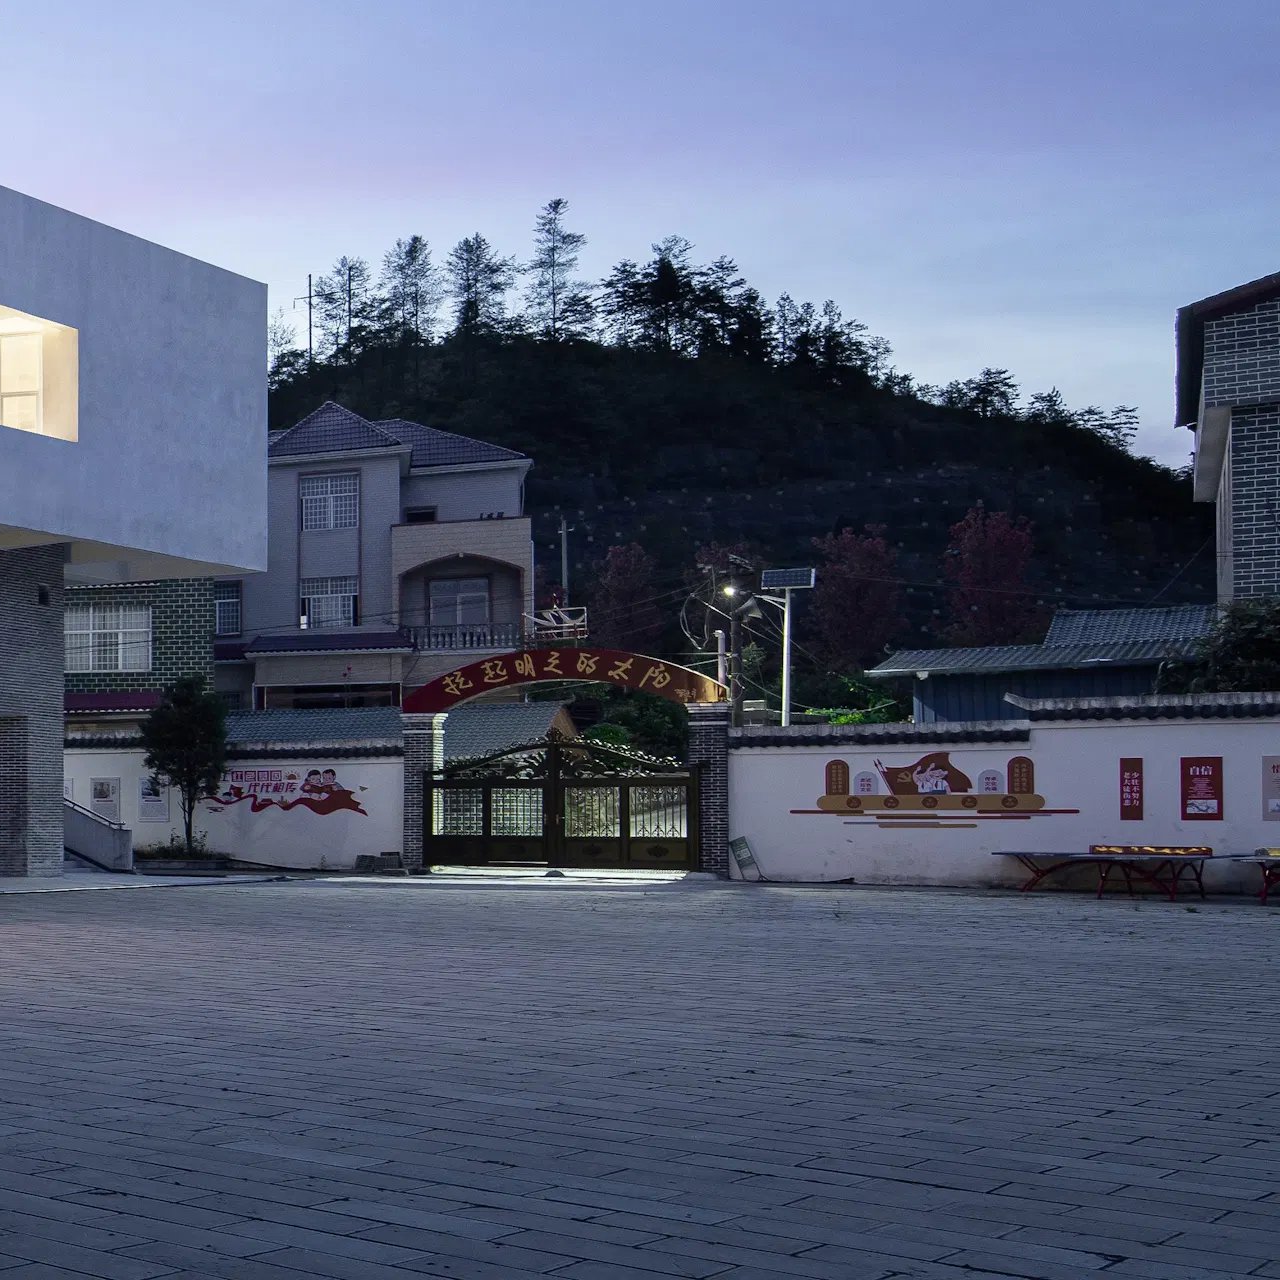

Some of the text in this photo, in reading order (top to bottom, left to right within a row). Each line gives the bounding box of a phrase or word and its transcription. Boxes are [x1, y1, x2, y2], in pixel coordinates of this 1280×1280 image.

[1190, 766, 1213, 775] 自信
[247, 782, 299, 793] 代代相传
[1131, 772, 1140, 806] 少壮不努力
